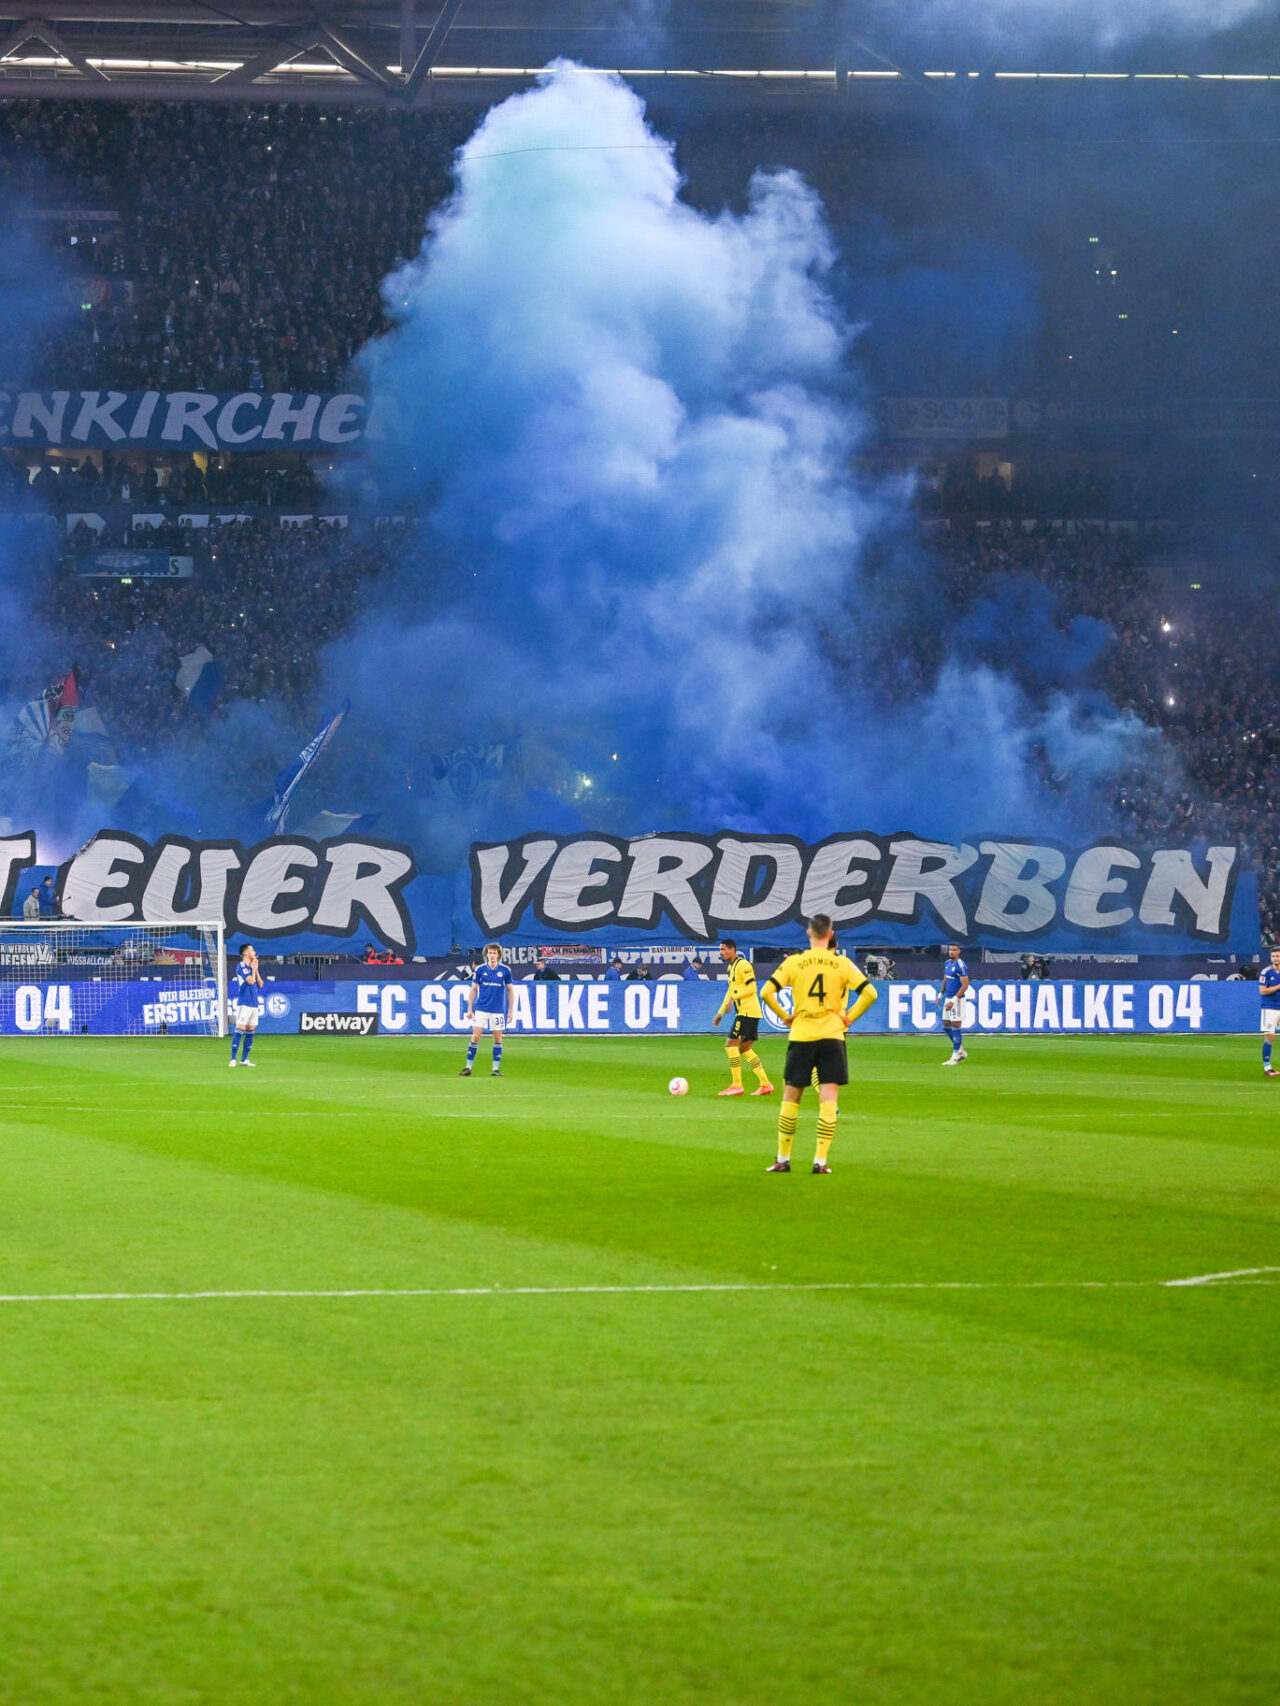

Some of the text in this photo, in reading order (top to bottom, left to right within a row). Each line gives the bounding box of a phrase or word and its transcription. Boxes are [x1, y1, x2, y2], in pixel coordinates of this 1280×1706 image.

[60, 837, 414, 948] EUER
[472, 836, 1237, 940] VERDERBEN
[797, 958, 840, 970] DORTMUND
[14, 984, 73, 1031] 04
[158, 987, 217, 1002] WIR BLEIBEN
[356, 983, 681, 1030] FC SCALKE 04
[808, 973, 827, 1004] 4
[888, 983, 937, 1030] FC
[1148, 983, 1203, 1029] 04
[301, 1012, 375, 1035] betway
